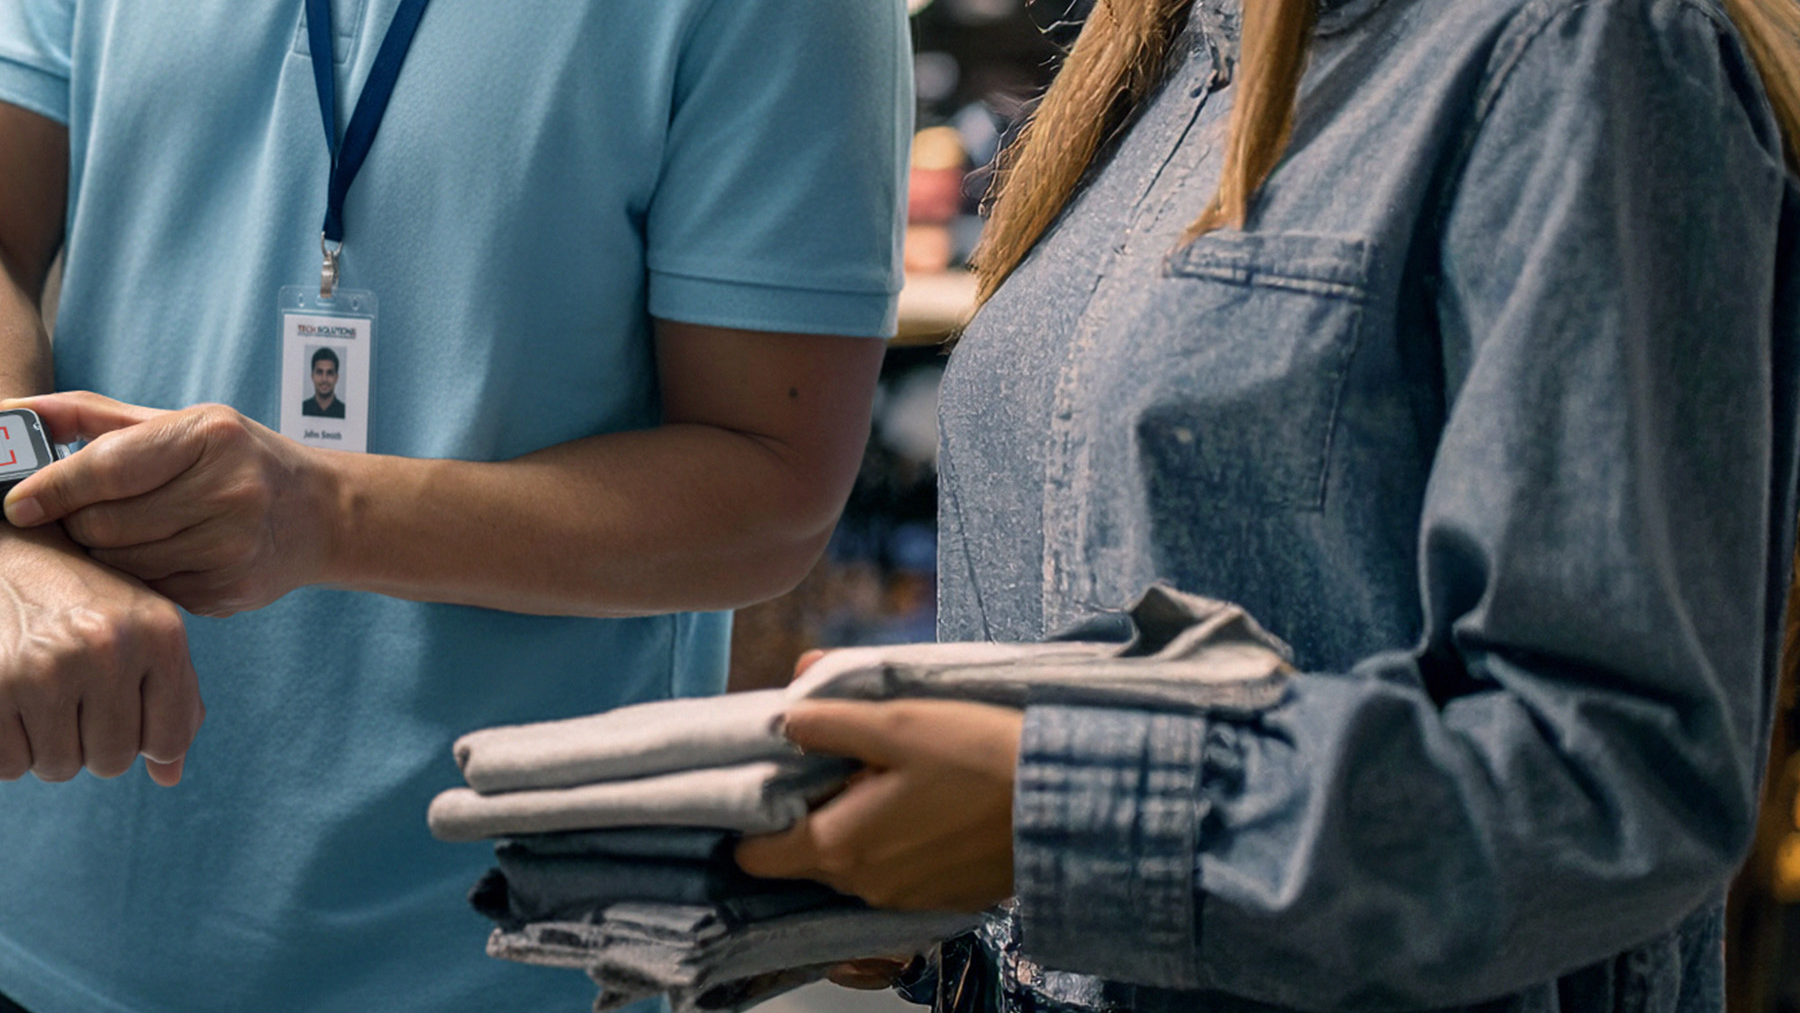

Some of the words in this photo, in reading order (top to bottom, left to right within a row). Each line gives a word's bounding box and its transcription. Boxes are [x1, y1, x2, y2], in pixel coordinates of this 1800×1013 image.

[297, 324, 316, 333] TECH
[303, 428, 320, 438] John
[321, 429, 342, 440] Smith
